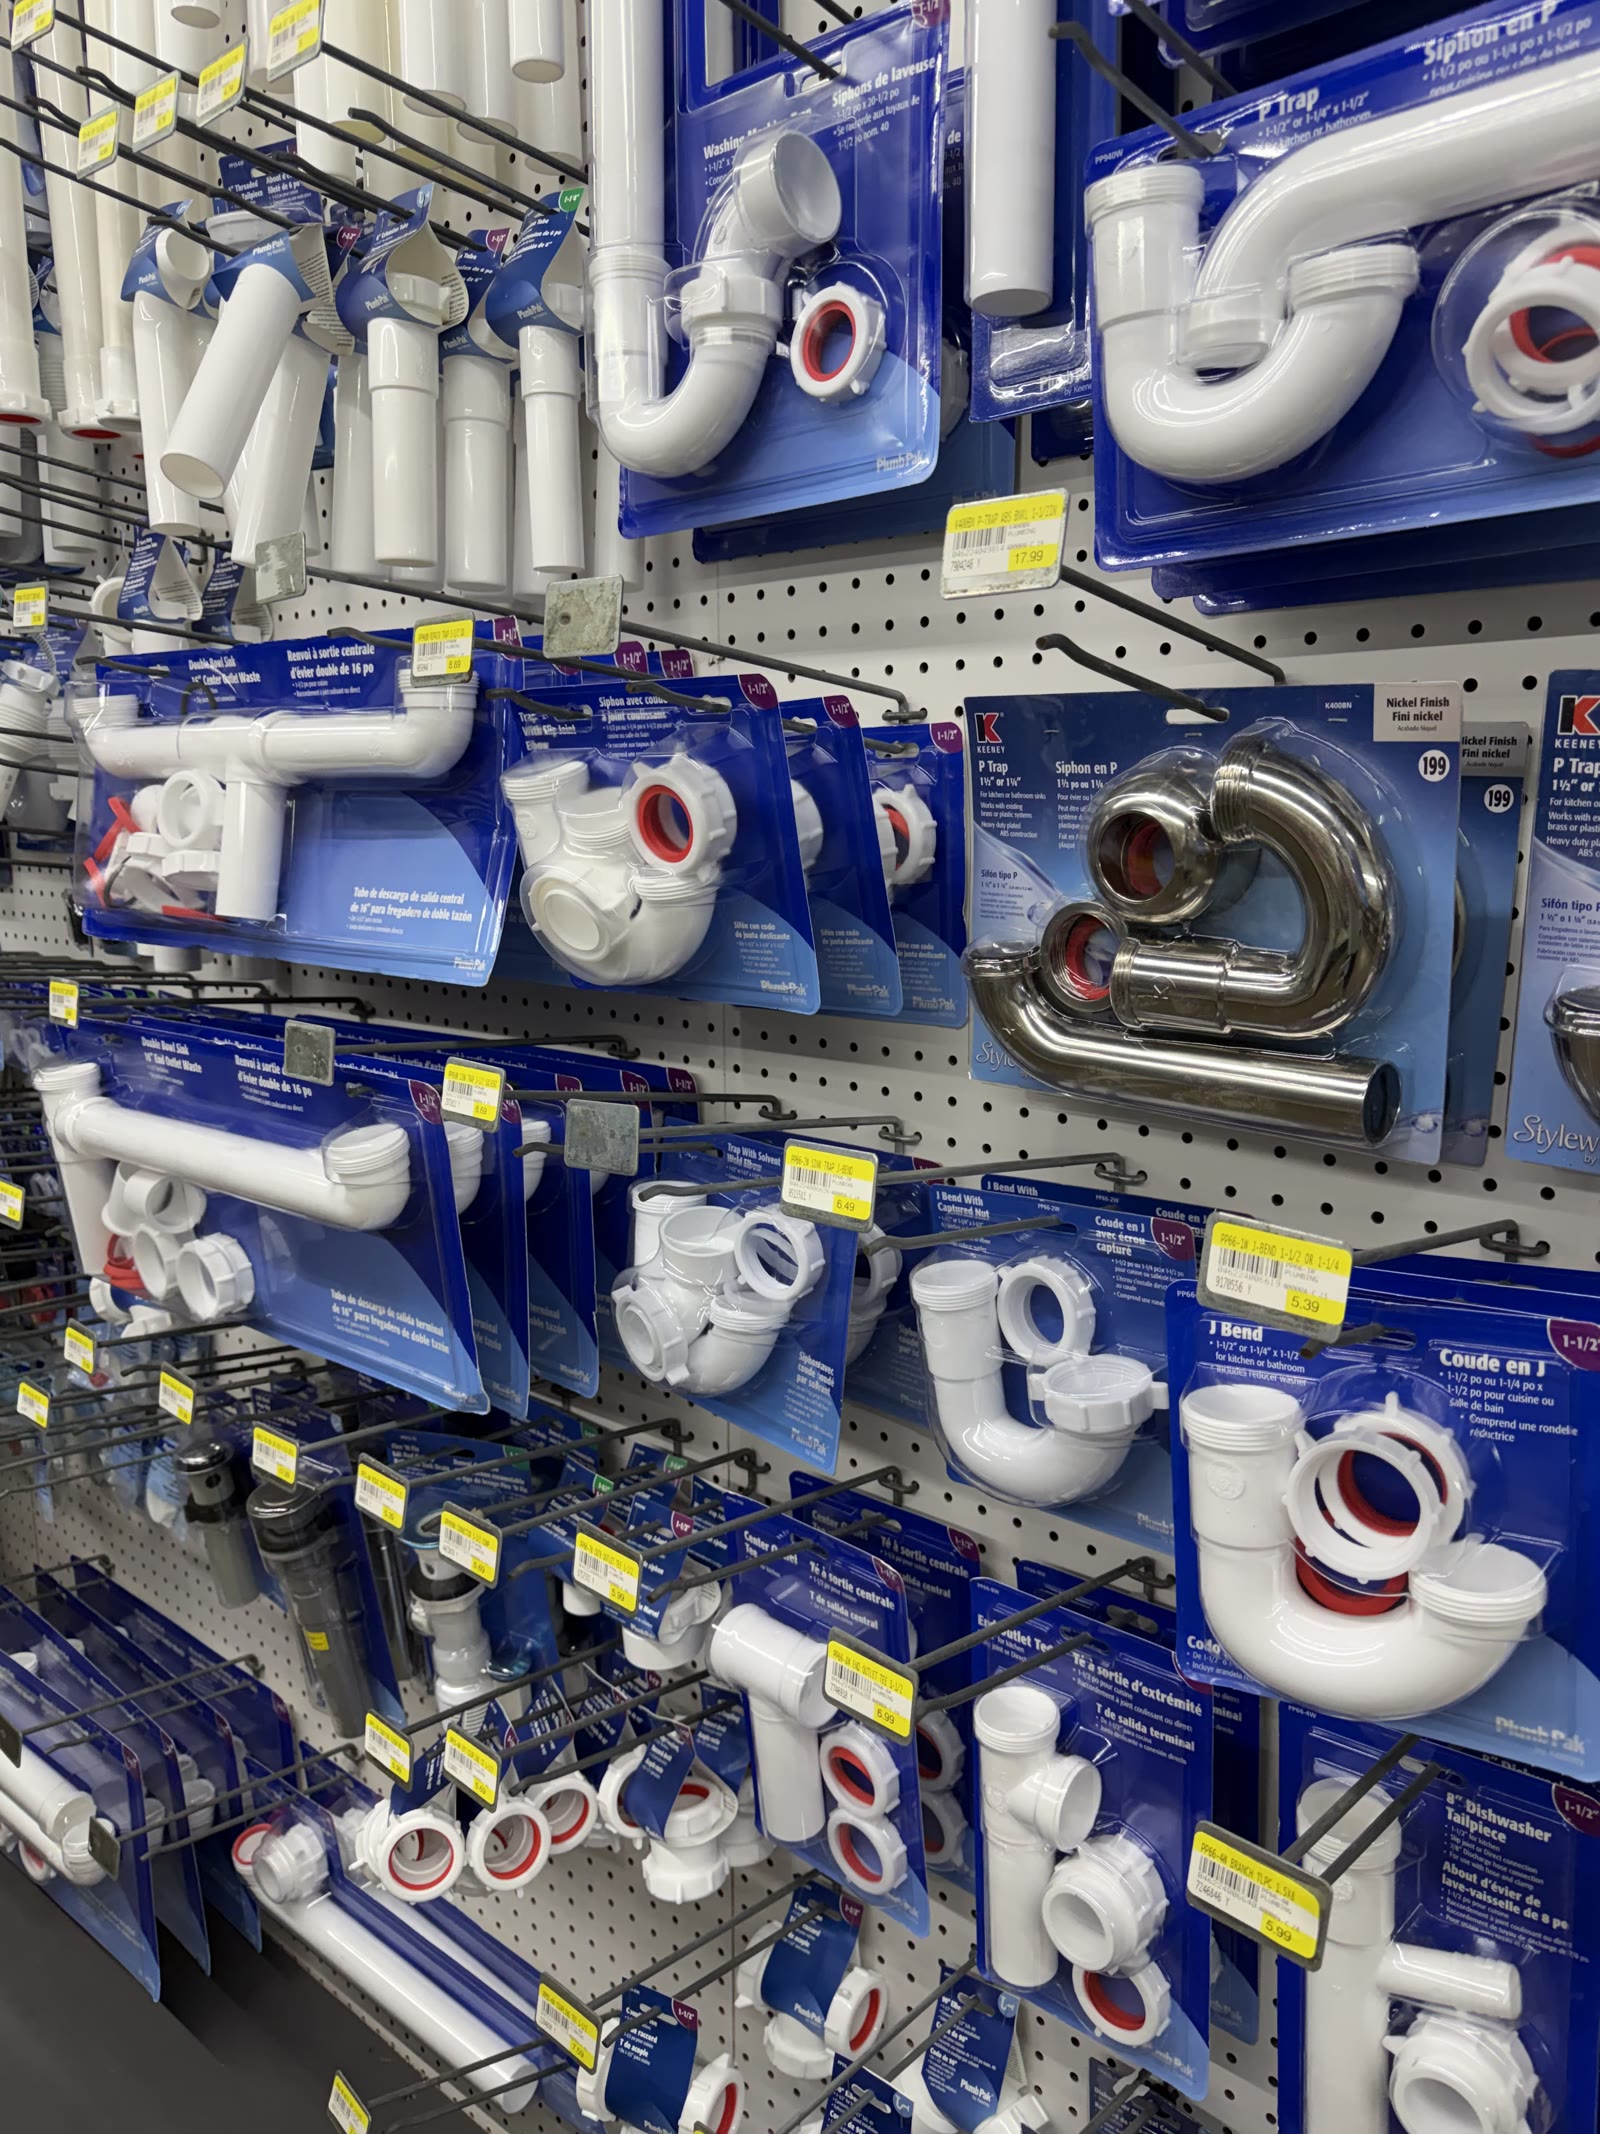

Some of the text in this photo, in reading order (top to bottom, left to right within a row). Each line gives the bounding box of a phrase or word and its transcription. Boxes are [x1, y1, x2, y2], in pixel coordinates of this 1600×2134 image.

[1424, 0, 1557, 65] Siphon en P
[832, 57, 936, 107] Siphons de laveuse
[1277, 87, 1320, 115] Trap
[1095, 149, 1124, 165] PP940W
[235, 179, 259, 193] Threaded
[1015, 550, 1044, 564] 17.99
[287, 643, 375, 663] Renvoi à sortie centrale
[290, 664, 375, 680] d'évier double de 16 po
[669, 659, 690, 672] 1-1/2"
[747, 683, 771, 697] 1-1/2"
[829, 701, 851, 715] 1-1/2"
[1386, 696, 1450, 708] Nickel Finish
[1392, 711, 1443, 722] Fini nickel
[936, 727, 958, 742] 1-1/2"
[977, 746, 1006, 754] KEENEY
[1461, 748, 1511, 759] Fini nickel
[978, 760, 1009, 775] P Trap
[1055, 761, 1118, 777] Siphon en P
[1422, 756, 1447, 775] 199
[1553, 758, 1565, 773] P
[980, 791, 988, 799] For
[988, 791, 1005, 799] kitchen
[1034, 792, 1047, 800] sinks
[1487, 789, 1512, 809] 199
[1548, 811, 1592, 822] Works with
[1547, 822, 1578, 832] brass or
[1546, 836, 1588, 849] Heavy duty
[353, 887, 465, 905] Tubo de descarga de salida central
[1541, 898, 1593, 913] Sifón tipo
[474, 1104, 488, 1116] 8.69
[727, 1142, 781, 1167] Trap With Solvent
[1584, 1153, 1597, 1165] by
[986, 1180, 1039, 1197] J Bend With
[836, 1199, 855, 1212] 6.49
[937, 1202, 990, 1219] Captured Nut
[1094, 1215, 1146, 1233] Coude en J
[1160, 1232, 1186, 1246] 1-1/2"
[1096, 1242, 1132, 1258] capturé
[1219, 1233, 1341, 1272] PP66-1W J-BEND 1-1/2 OR 1-1/4
[1290, 1296, 1320, 1313] 5.39
[1208, 1320, 1264, 1342] J Bend
[1216, 1340, 1237, 1353] 1-1/2"
[1238, 1344, 1248, 1352] or
[1250, 1345, 1272, 1356] 1-1/4"
[1280, 1349, 1300, 1360] 1-1/2
[1215, 1351, 1306, 1374] for kitchen or bathroom
[1439, 1348, 1546, 1378] Coude en J
[1447, 1371, 1544, 1392] 1-1/2 po ou 1-1/4 po x
[1446, 1384, 1555, 1407] 1-1/2 po pour cuisine ou
[1448, 1398, 1505, 1415] salle de bain
[1469, 1413, 1579, 1437] Comprend une rondelle
[1469, 1428, 1515, 1443] réductrice
[473, 1560, 486, 1574] 5.69
[809, 1560, 895, 1611] Té à sortie centrale
[611, 1588, 625, 1602] 5.99
[1186, 1635, 1221, 1655] Codo
[1072, 1651, 1203, 1717] Té à sortie d'extrémité
[876, 1708, 895, 1725] 6.99
[1445, 1792, 1552, 1843] 8" Dishwasher
[1564, 1800, 1600, 1820] 1-1/2"
[1445, 1806, 1508, 1844] Tailpiece
[1229, 1856, 1273, 1888] BRANCH TLPC
[1442, 1860, 1542, 1908] About d'évier de
[1441, 1873, 1570, 1930] lave-vaisselle de 8 po
[1265, 1920, 1292, 1942] 5.99
[677, 2007, 695, 2021] 1-1/2"
